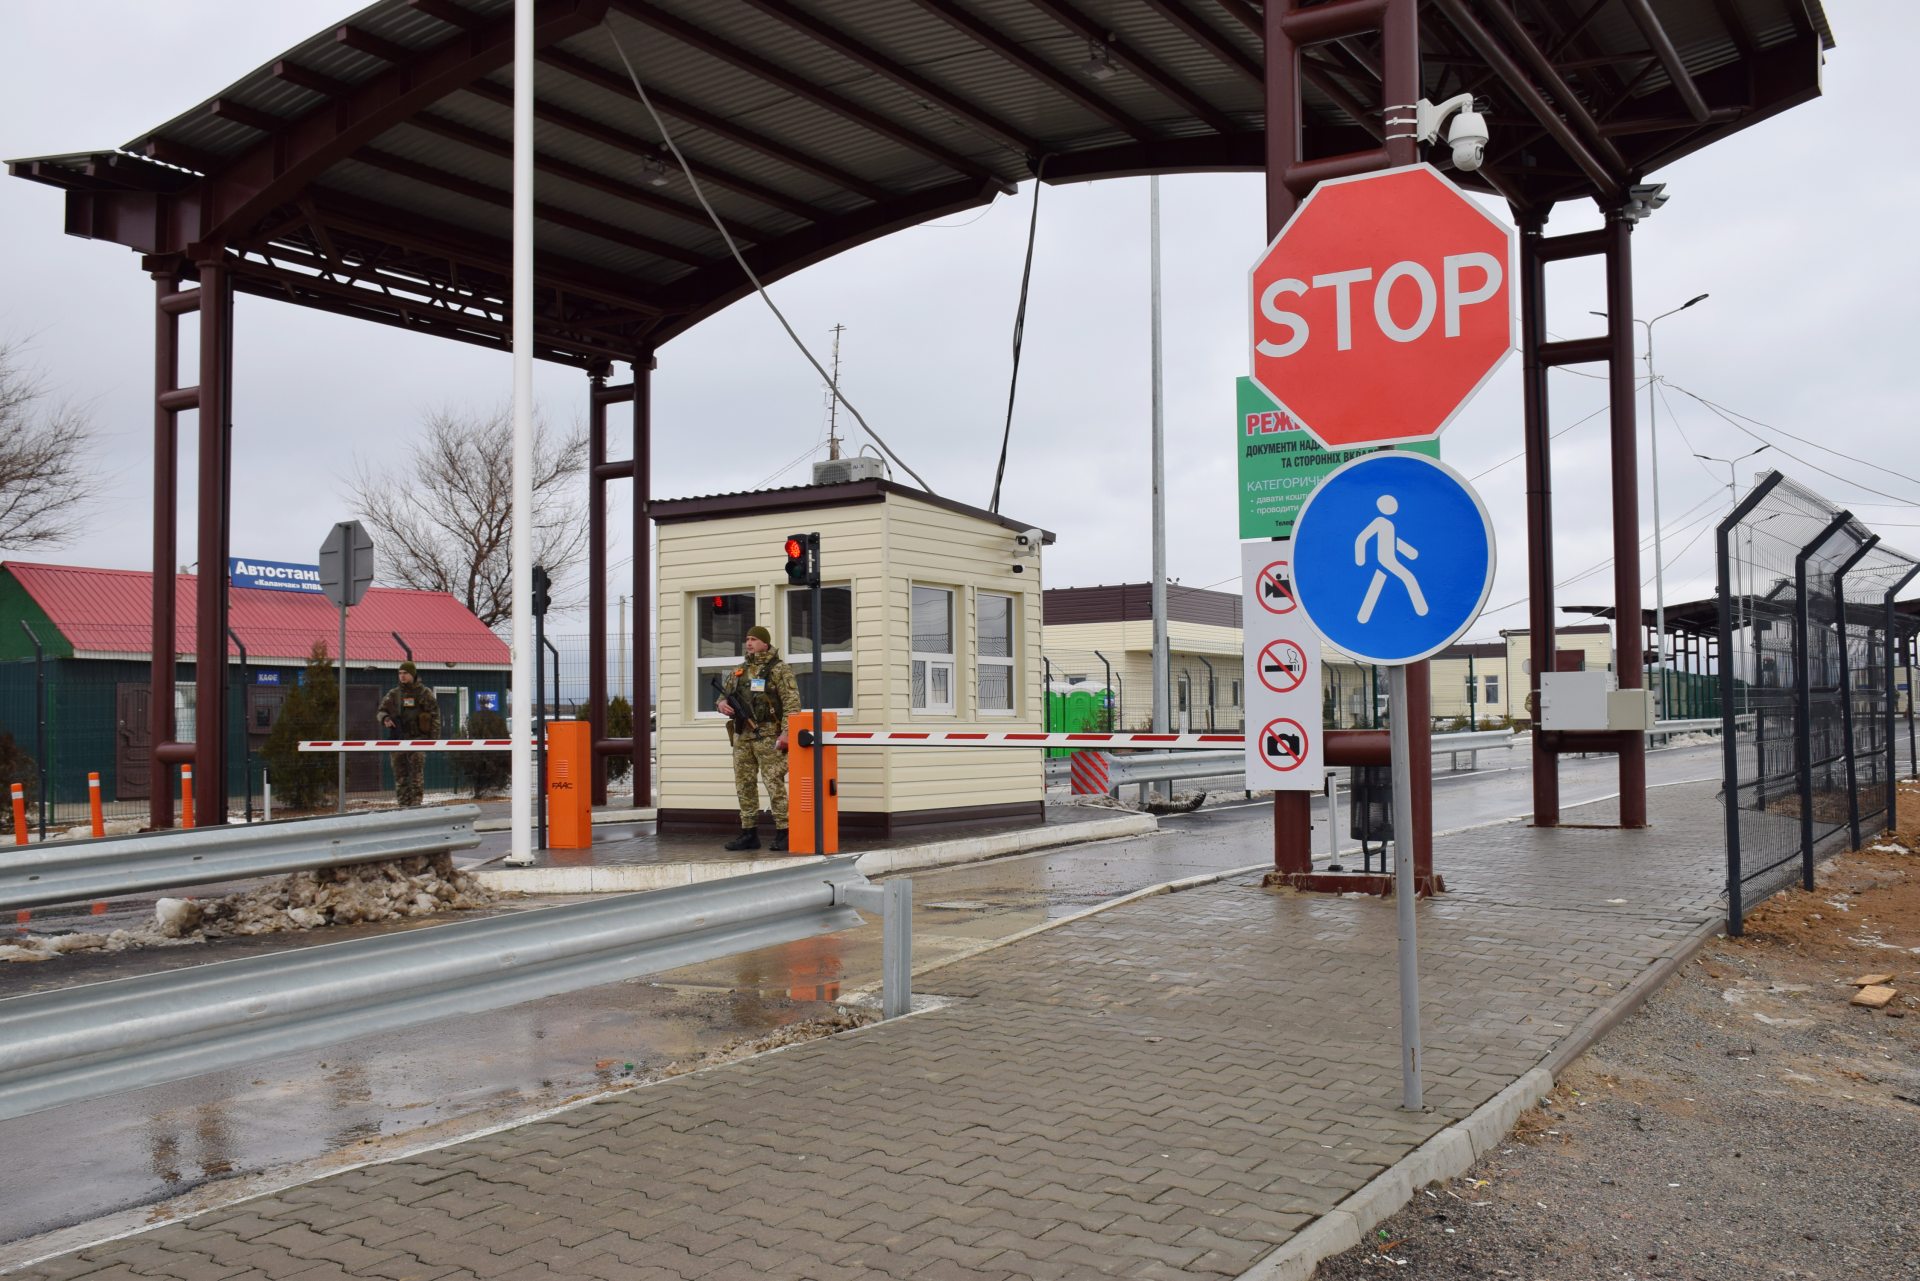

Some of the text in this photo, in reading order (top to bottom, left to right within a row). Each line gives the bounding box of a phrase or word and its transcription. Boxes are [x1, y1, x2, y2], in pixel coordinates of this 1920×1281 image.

[1256, 252, 1503, 358] STOP
[1246, 411, 1302, 436] РЕЖ
[1246, 441, 1297, 458] ДОКУМЕНТИ
[1281, 457, 1293, 468] ТА
[1294, 452, 1341, 467] СТОРОННІХ
[1256, 493, 1309, 504] давати кошт
[1256, 505, 1299, 515] проводити
[551, 781, 573, 789] FAAC
